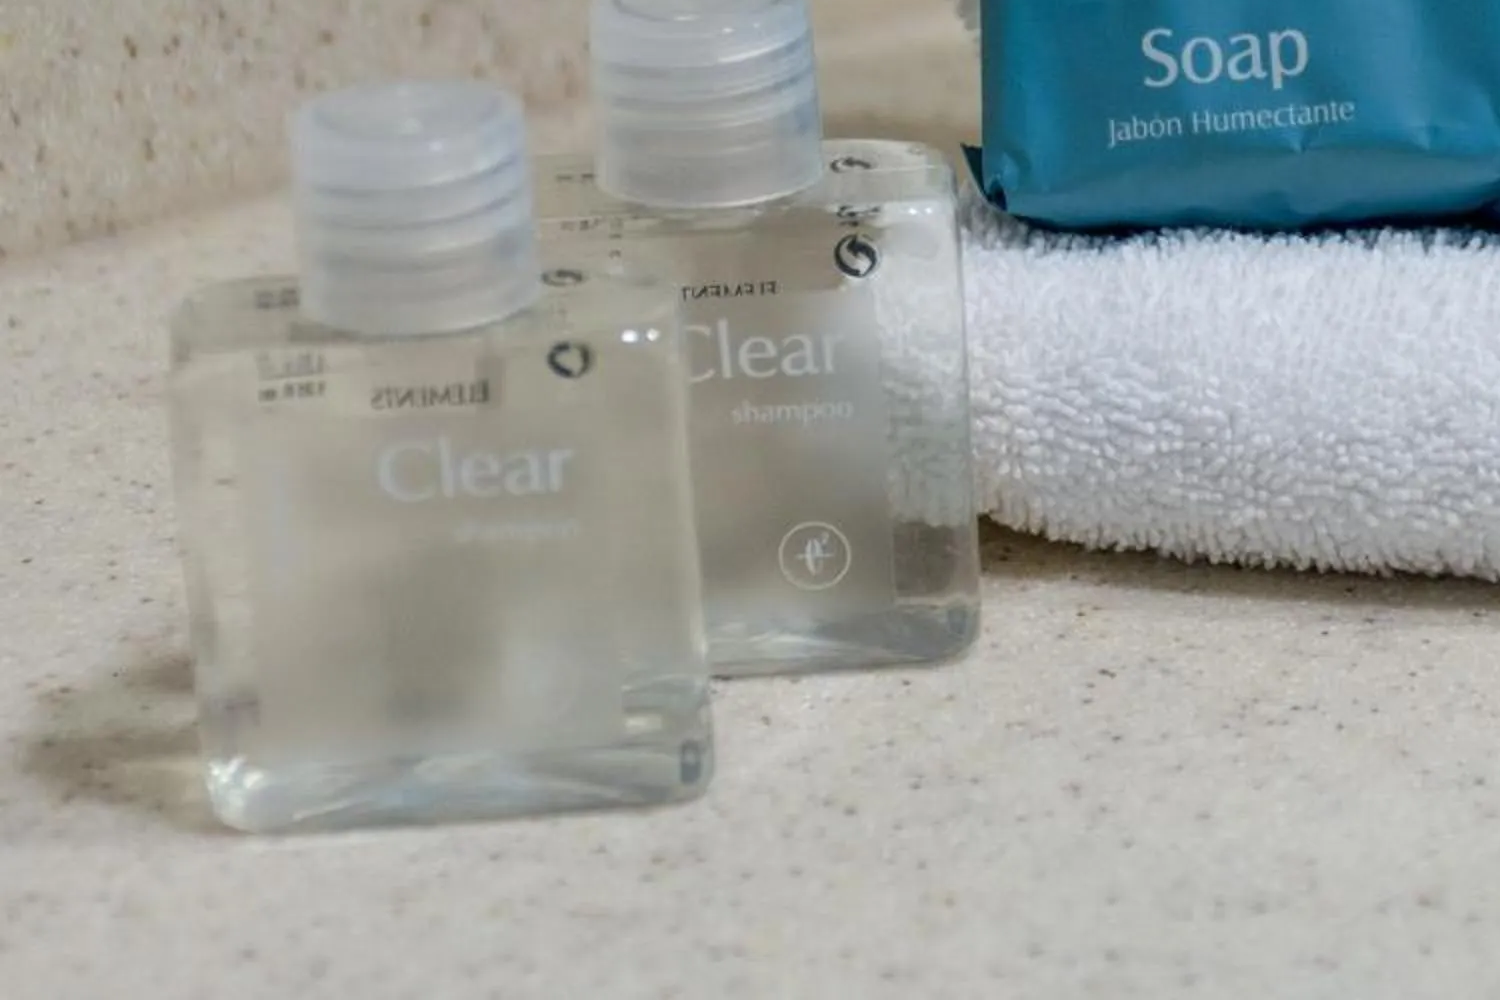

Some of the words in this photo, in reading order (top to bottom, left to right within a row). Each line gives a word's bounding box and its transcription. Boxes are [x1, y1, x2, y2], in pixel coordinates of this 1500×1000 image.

[1141, 27, 1309, 91] Soap
[1107, 113, 1183, 149] Jabón
[1192, 101, 1356, 135] Humectante
[730, 398, 855, 426] shampoo
[376, 435, 575, 502] Clear
